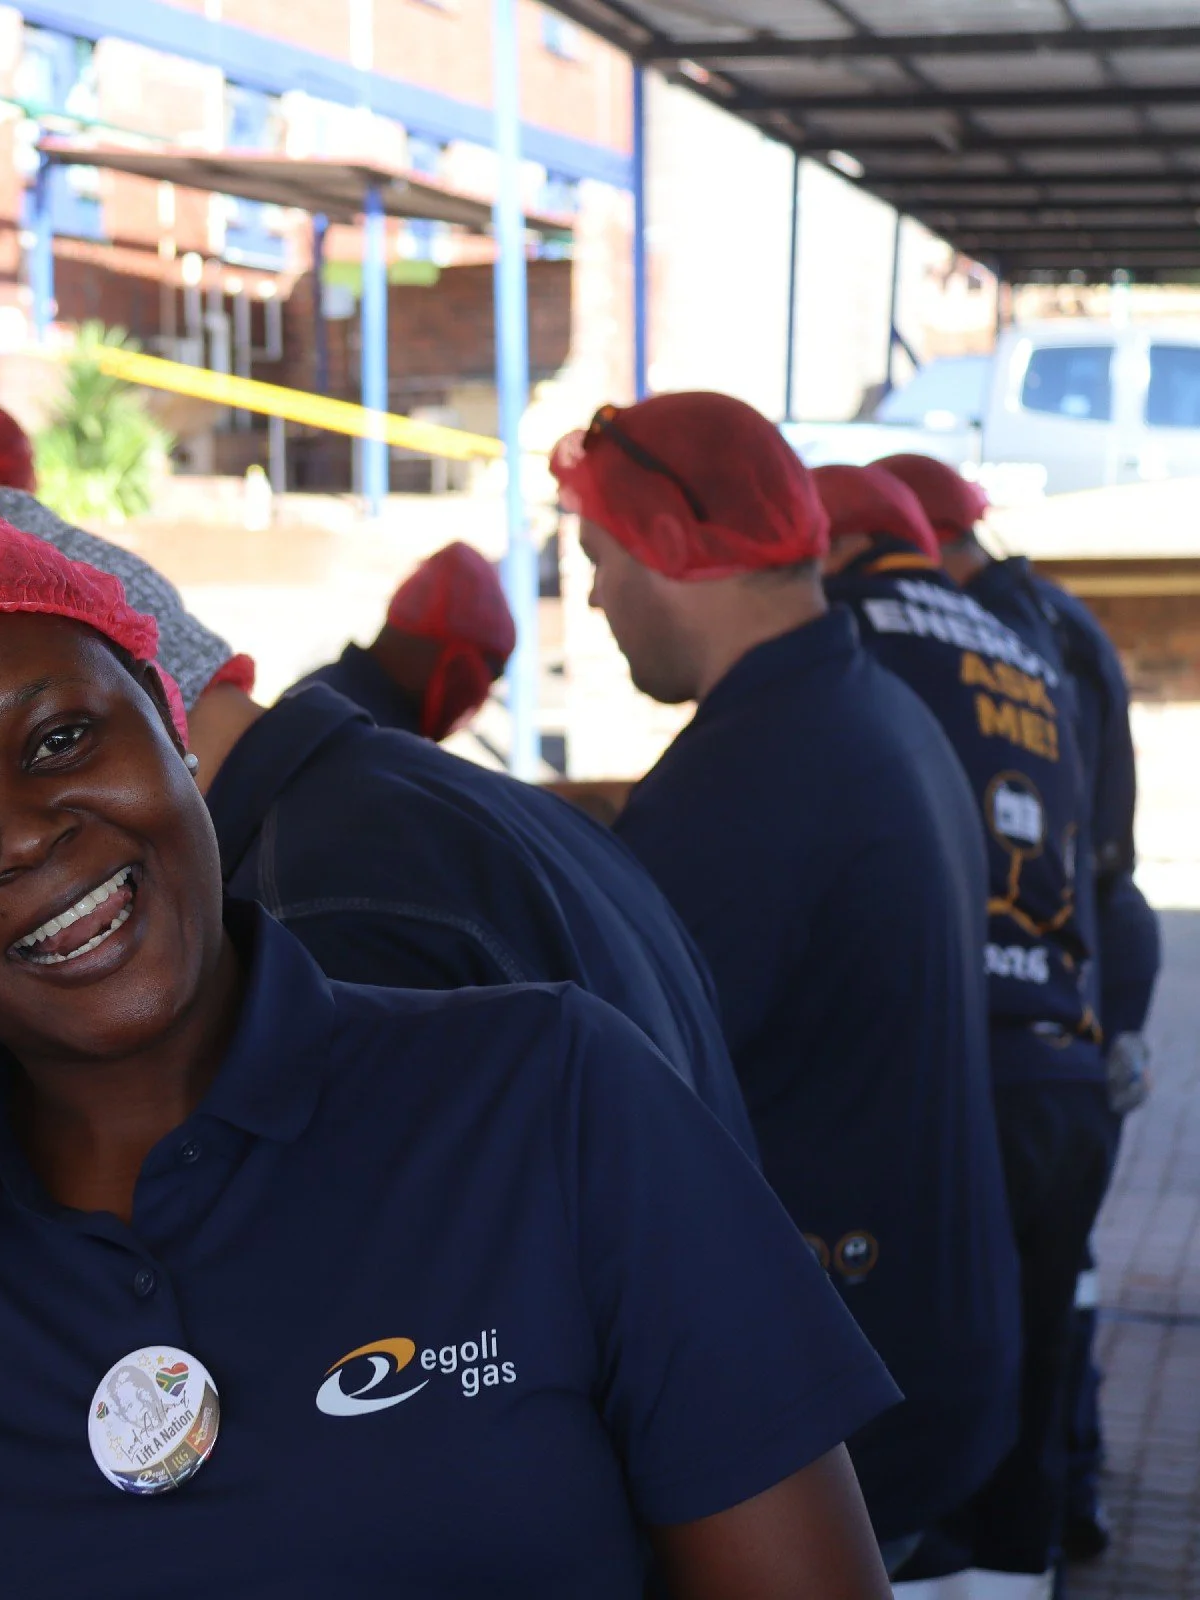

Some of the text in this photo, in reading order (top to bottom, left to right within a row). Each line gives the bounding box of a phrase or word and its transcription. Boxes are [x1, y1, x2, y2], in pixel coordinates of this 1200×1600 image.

[420, 1328, 498, 1374] egoli
[461, 1361, 517, 1397] gas
[136, 1446, 156, 1466] Lift
[154, 1437, 164, 1449] A
[160, 1409, 195, 1443] Nation
